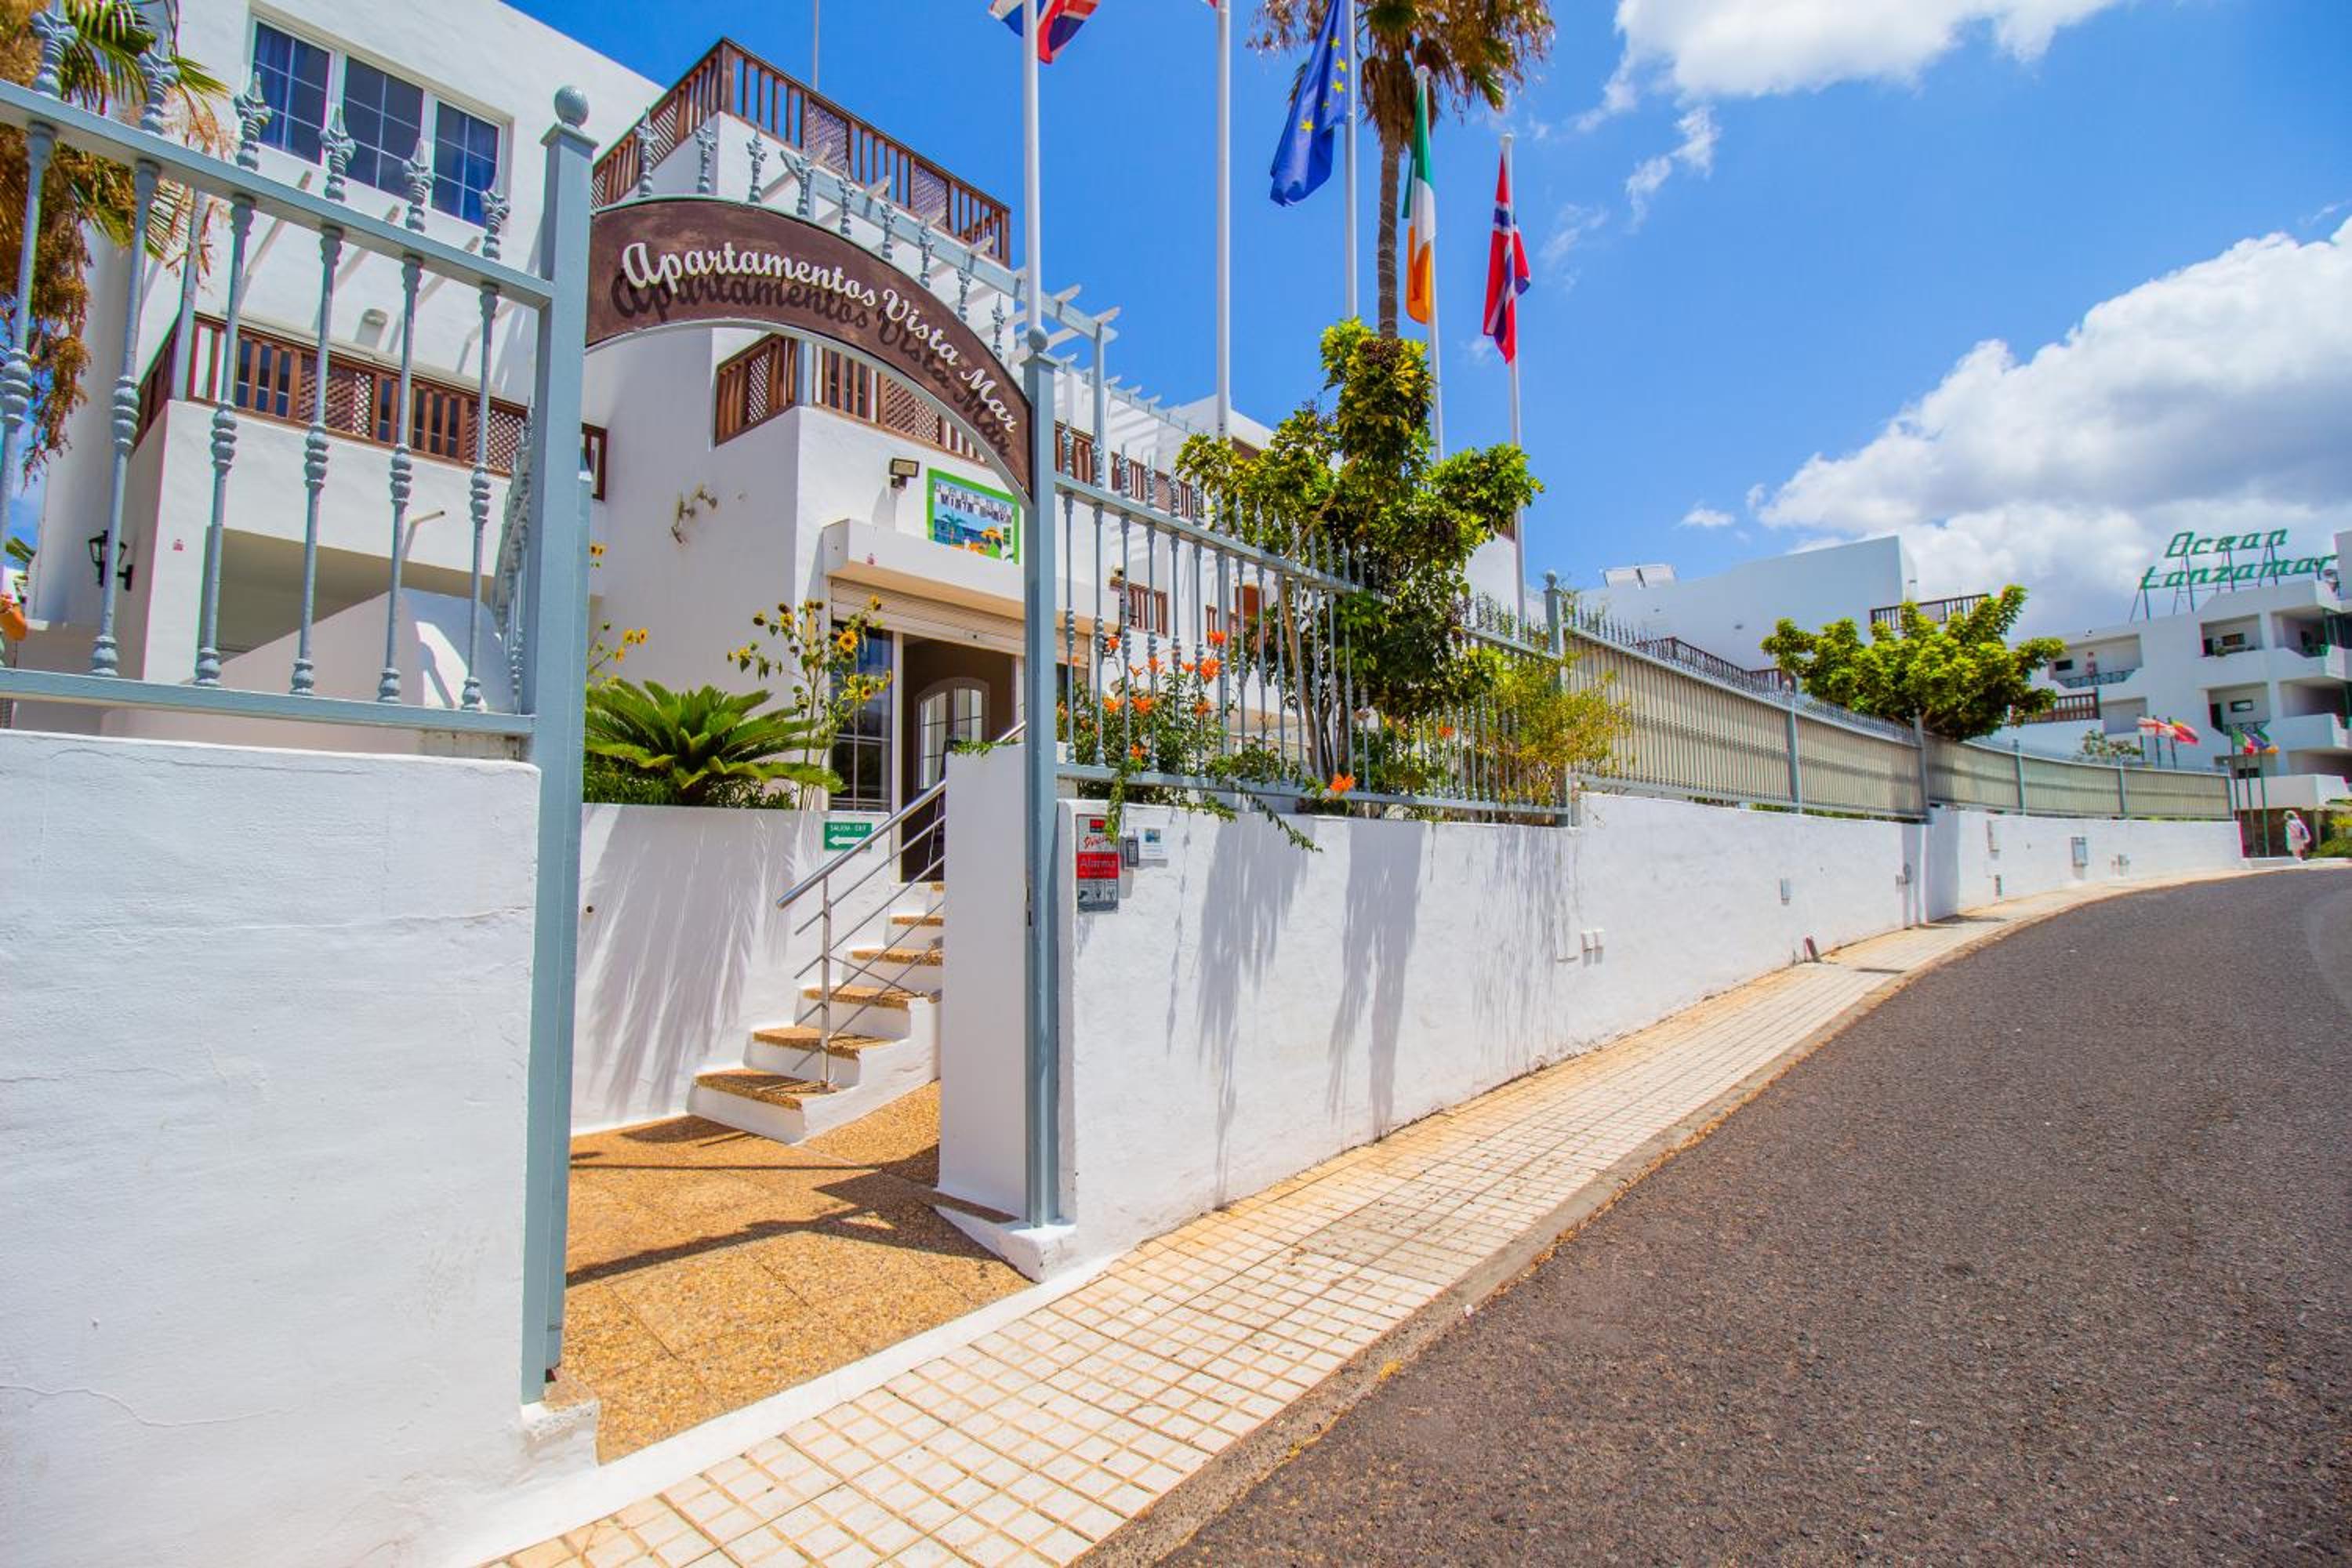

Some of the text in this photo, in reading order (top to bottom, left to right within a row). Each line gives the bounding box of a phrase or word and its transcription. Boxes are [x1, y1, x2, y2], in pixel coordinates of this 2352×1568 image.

[622, 242, 1016, 433] Apartamentos Vista Mar
[2165, 528, 2288, 557] Ocean
